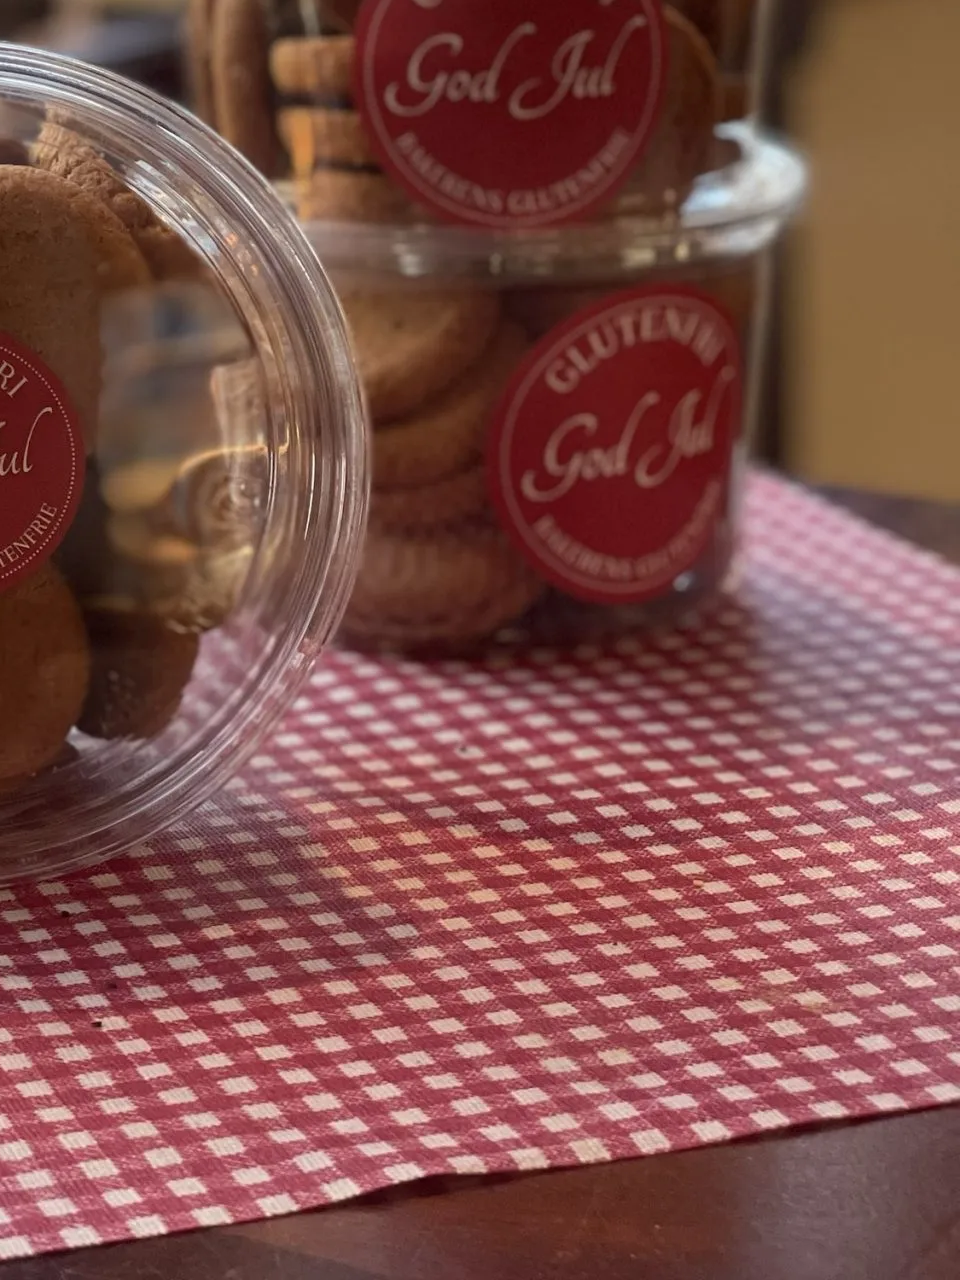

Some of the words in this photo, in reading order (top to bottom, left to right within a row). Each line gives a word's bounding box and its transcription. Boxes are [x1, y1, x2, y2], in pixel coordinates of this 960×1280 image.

[384, 21, 537, 117] God
[508, 14, 646, 120] Jul
[520, 390, 661, 502] God
[634, 365, 737, 488] Jul
